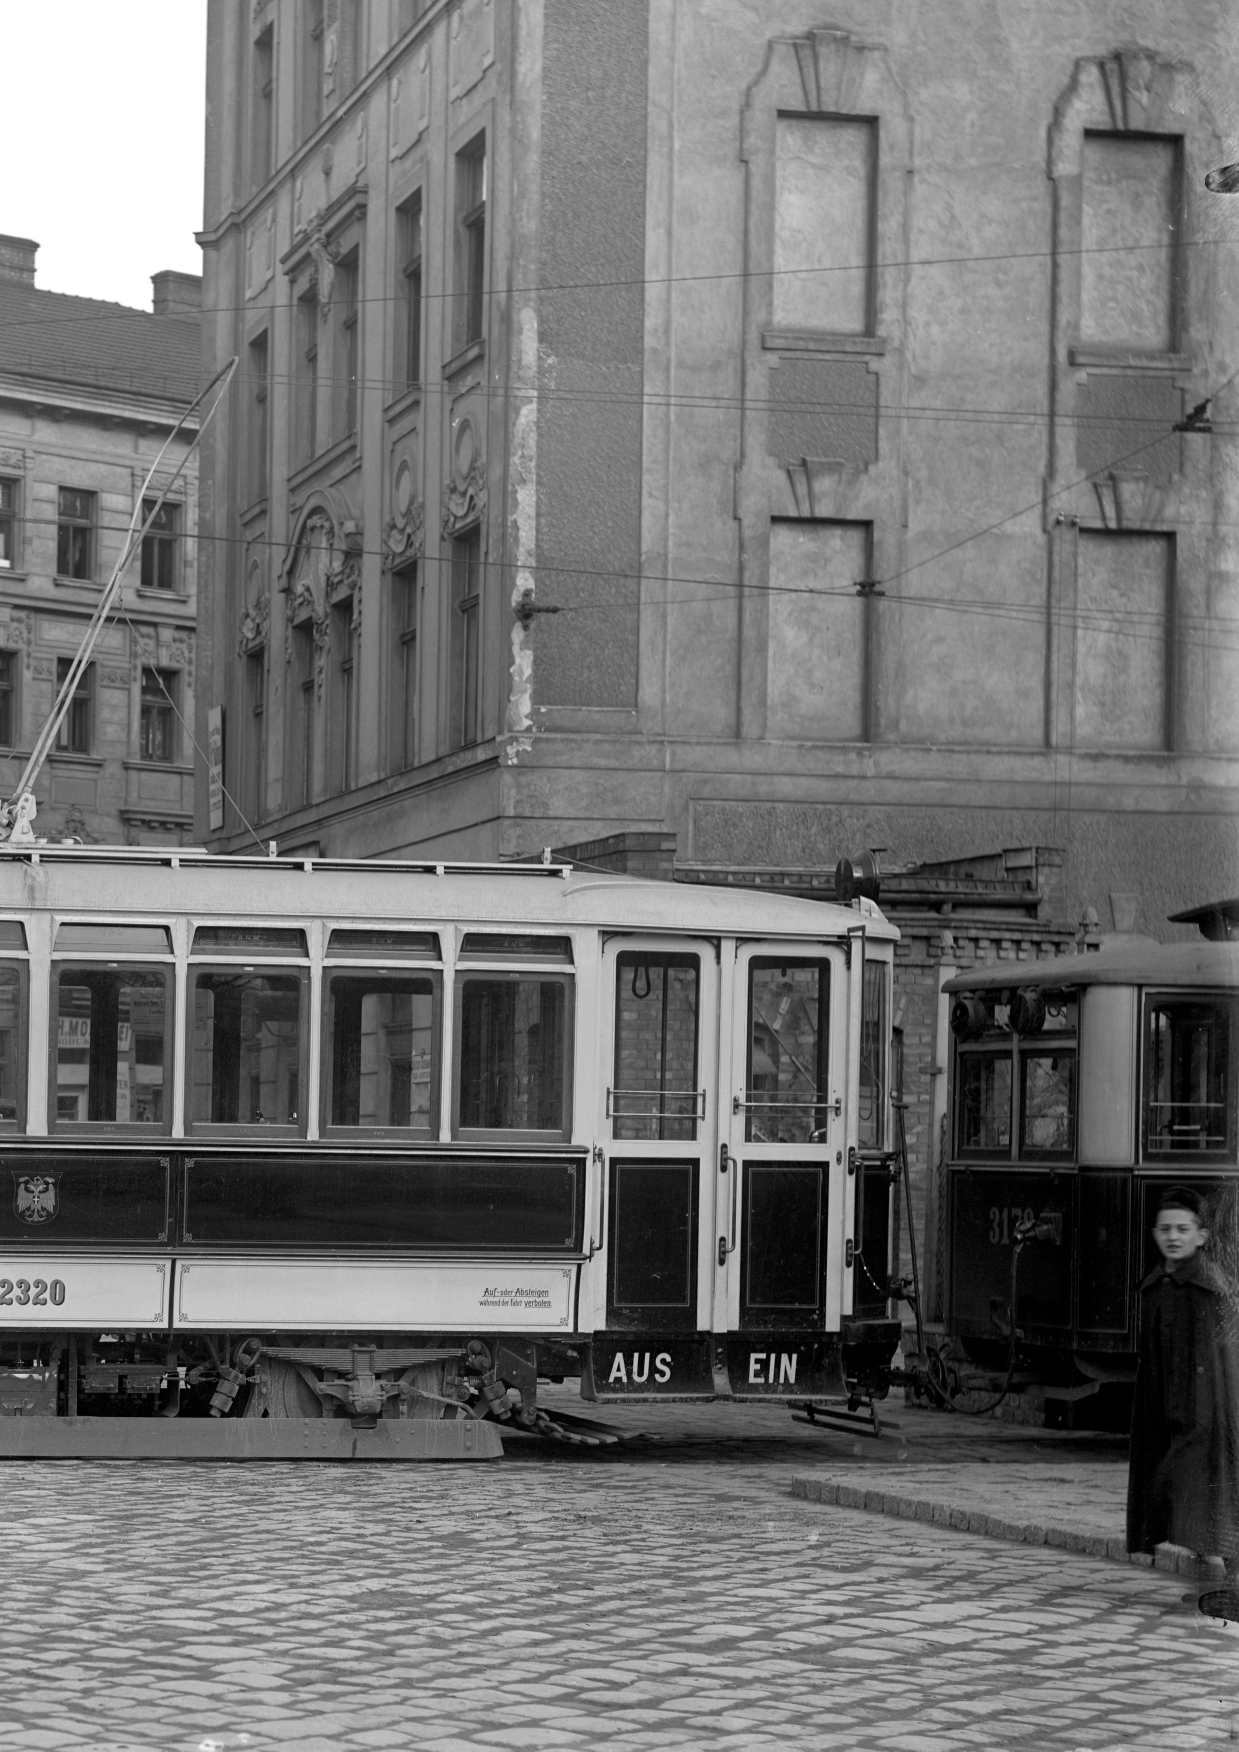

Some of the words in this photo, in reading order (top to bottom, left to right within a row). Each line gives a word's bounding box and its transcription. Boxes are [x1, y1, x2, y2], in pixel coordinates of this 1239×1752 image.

[514, 1288, 549, 1298] Absteigen
[510, 1299, 523, 1307] Fahrt
[609, 1352, 673, 1383] AUS
[748, 1352, 798, 1384] EIN
